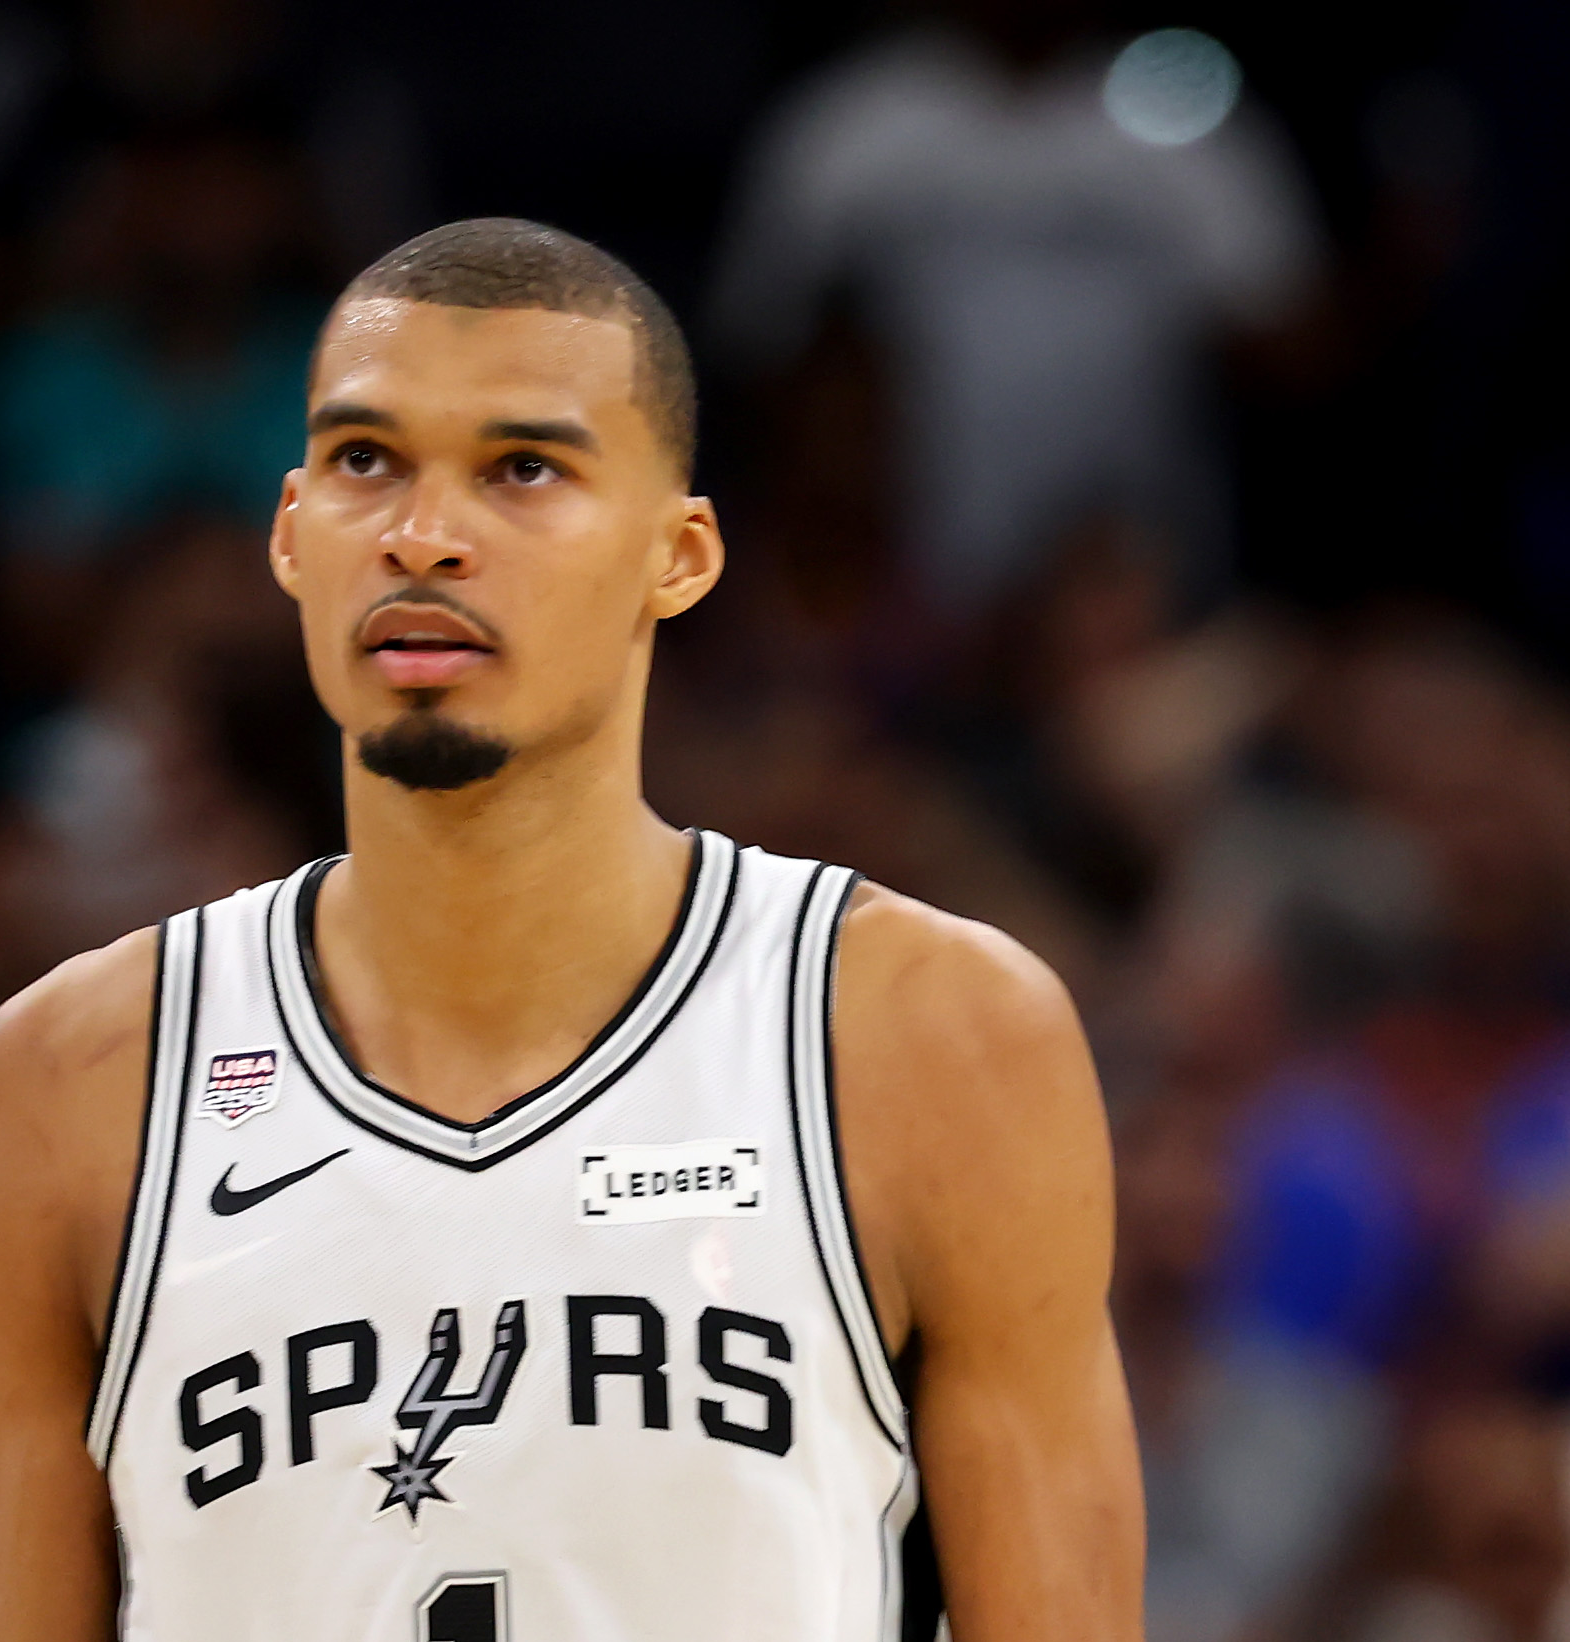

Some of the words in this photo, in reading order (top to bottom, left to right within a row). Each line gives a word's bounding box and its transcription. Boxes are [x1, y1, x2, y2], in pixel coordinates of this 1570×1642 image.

[211, 1055, 275, 1079] USA
[606, 1165, 736, 1198] LEDGER
[178, 1294, 793, 1528] SPURS
